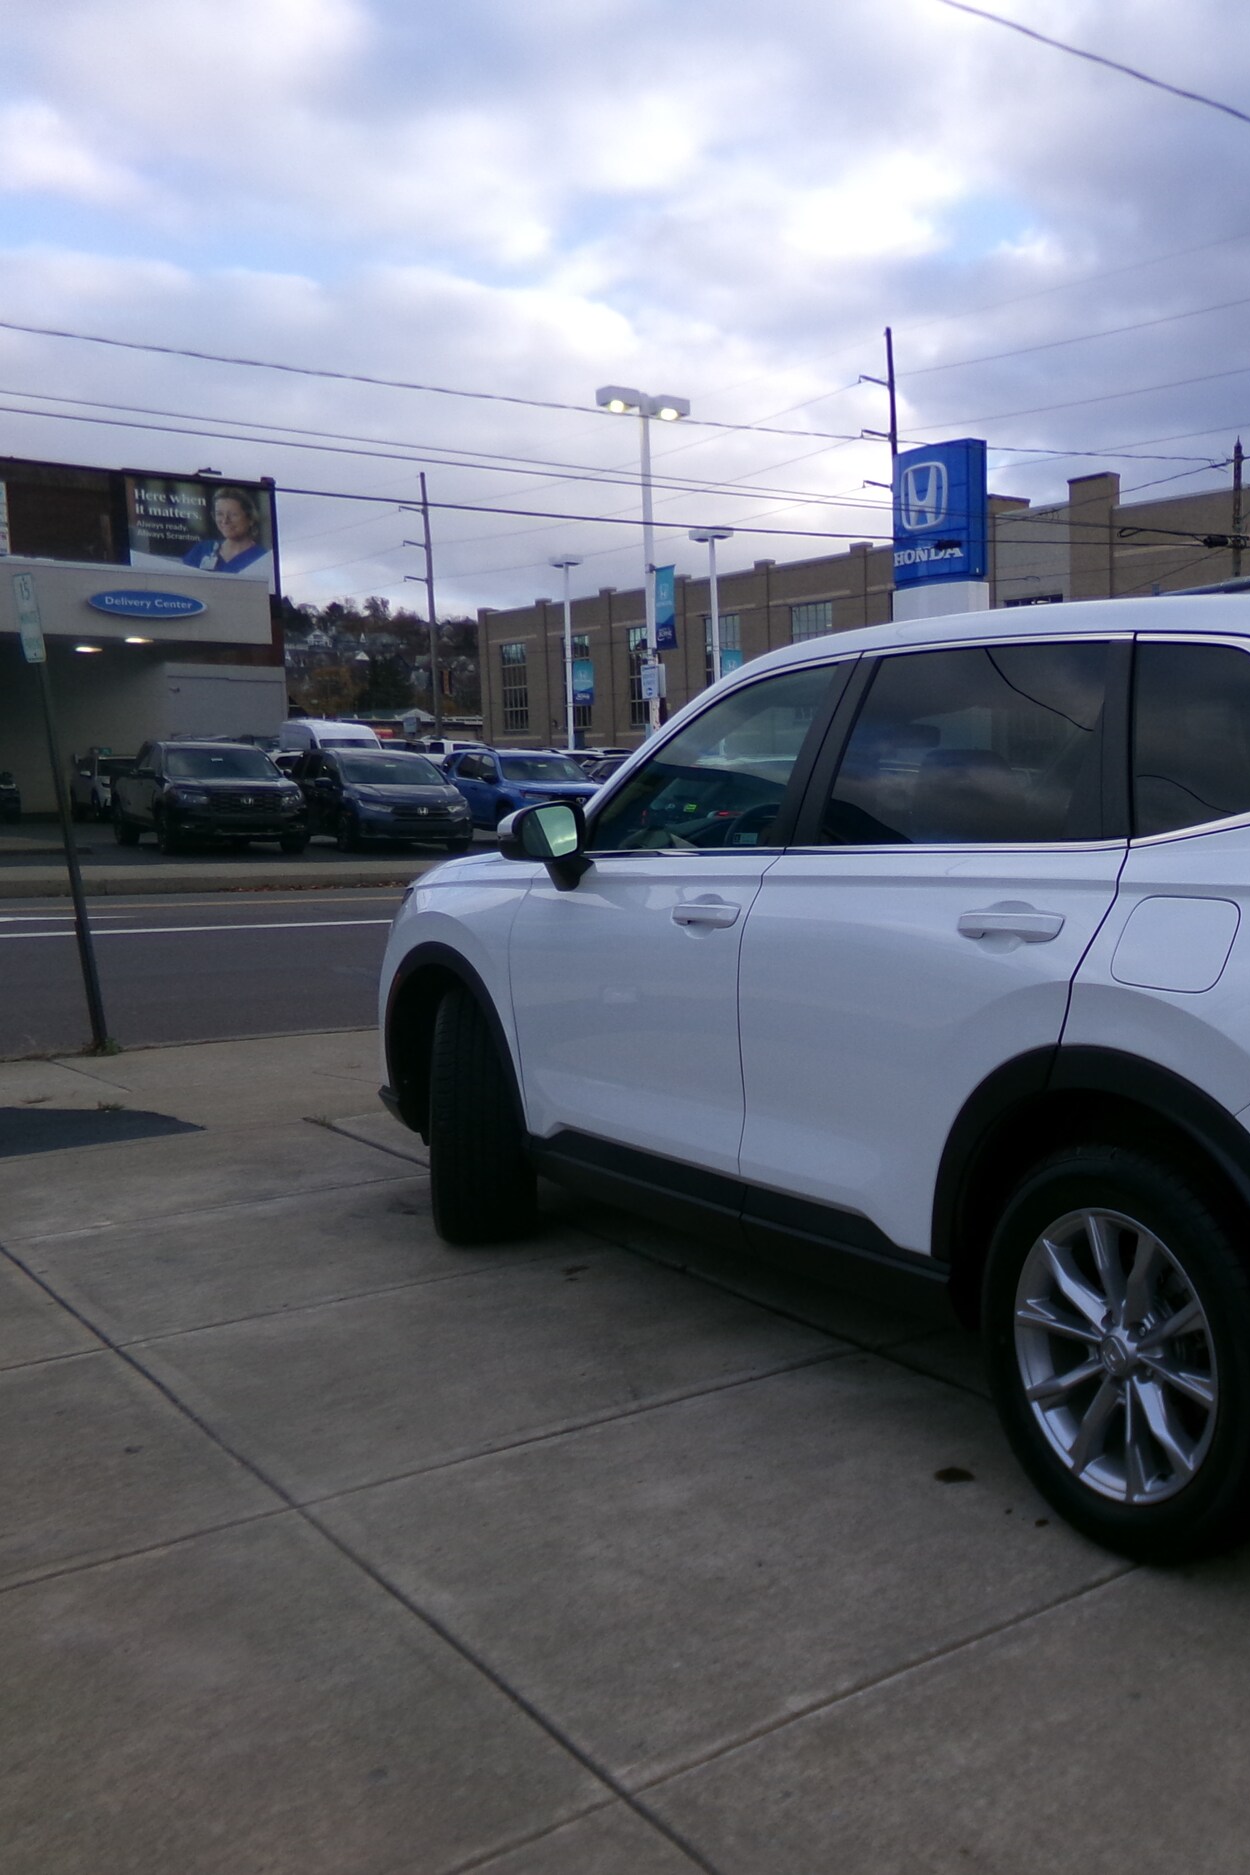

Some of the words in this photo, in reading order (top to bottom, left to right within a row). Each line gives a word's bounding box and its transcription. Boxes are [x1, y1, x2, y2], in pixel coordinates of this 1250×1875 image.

[133, 488, 166, 502] Here
[169, 493, 207, 507] when
[135, 503, 144, 515] it
[136, 520, 164, 530] Always
[104, 596, 151, 609] Delivery
[154, 599, 193, 609] Center
